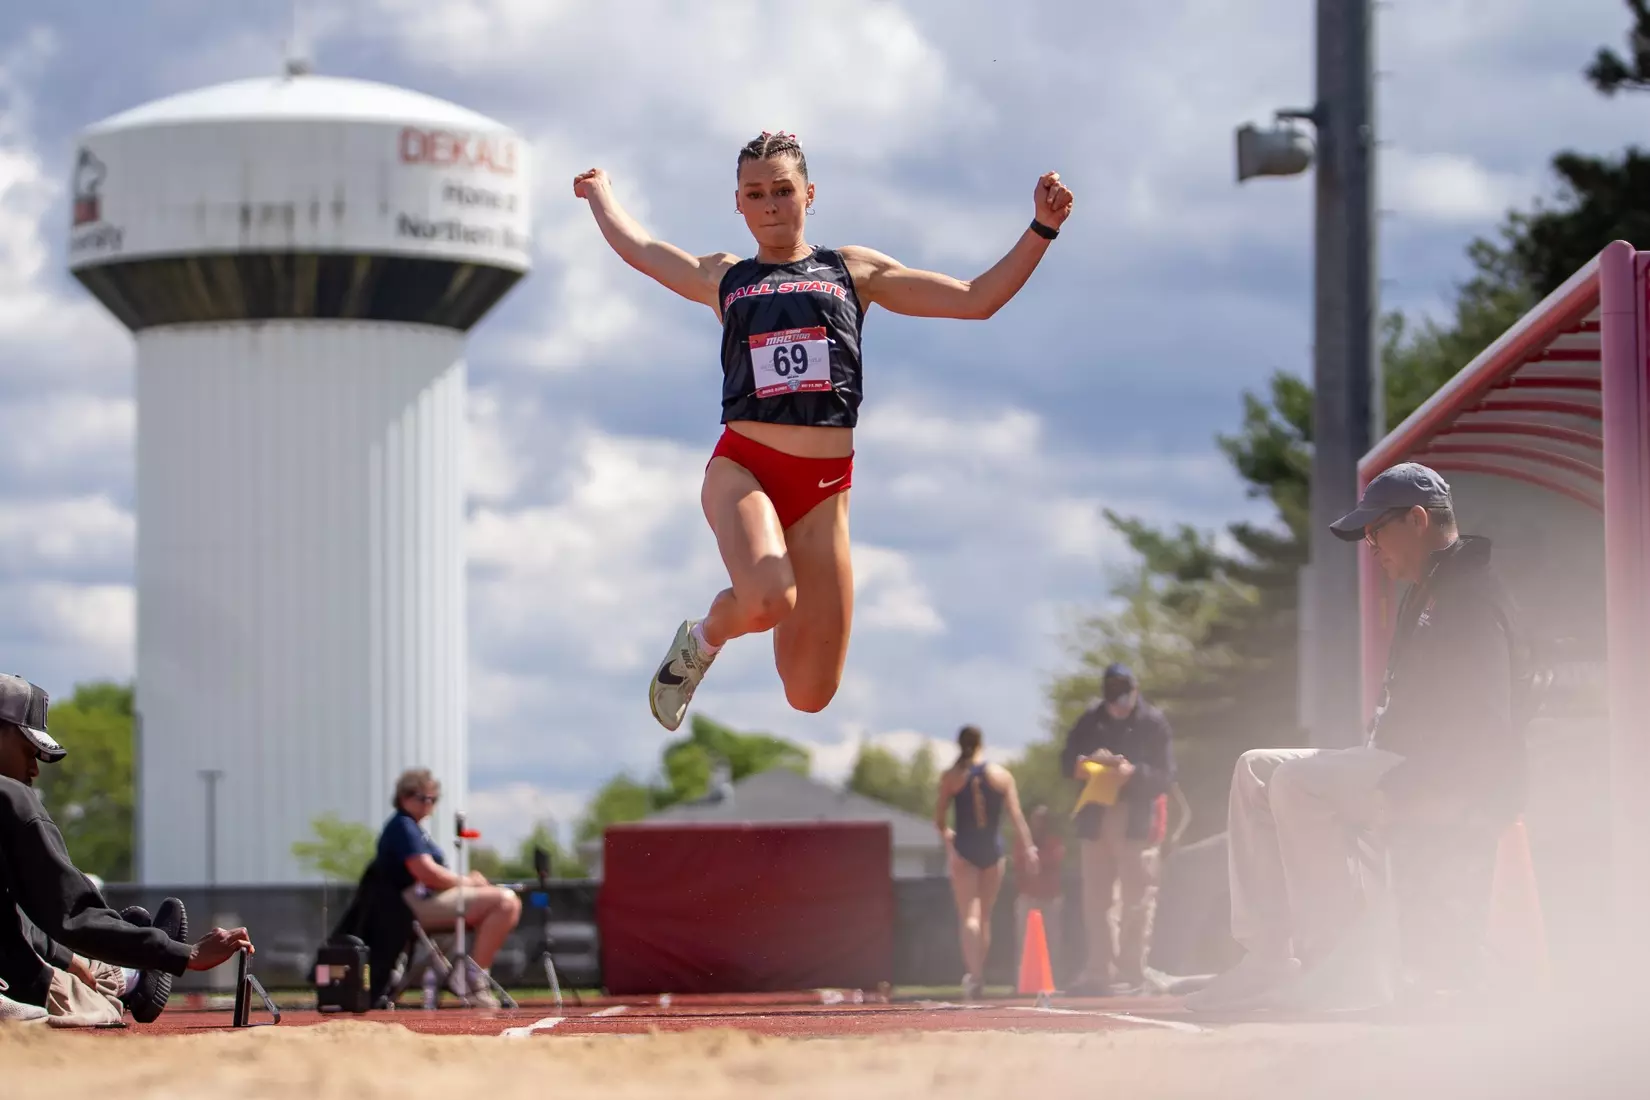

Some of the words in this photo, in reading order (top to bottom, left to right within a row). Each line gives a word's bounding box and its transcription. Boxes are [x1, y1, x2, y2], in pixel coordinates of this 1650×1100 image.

[724, 283, 775, 314] BALL
[777, 280, 847, 302] STATE
[773, 343, 808, 377] 69
[680, 649, 697, 669] NIKE
